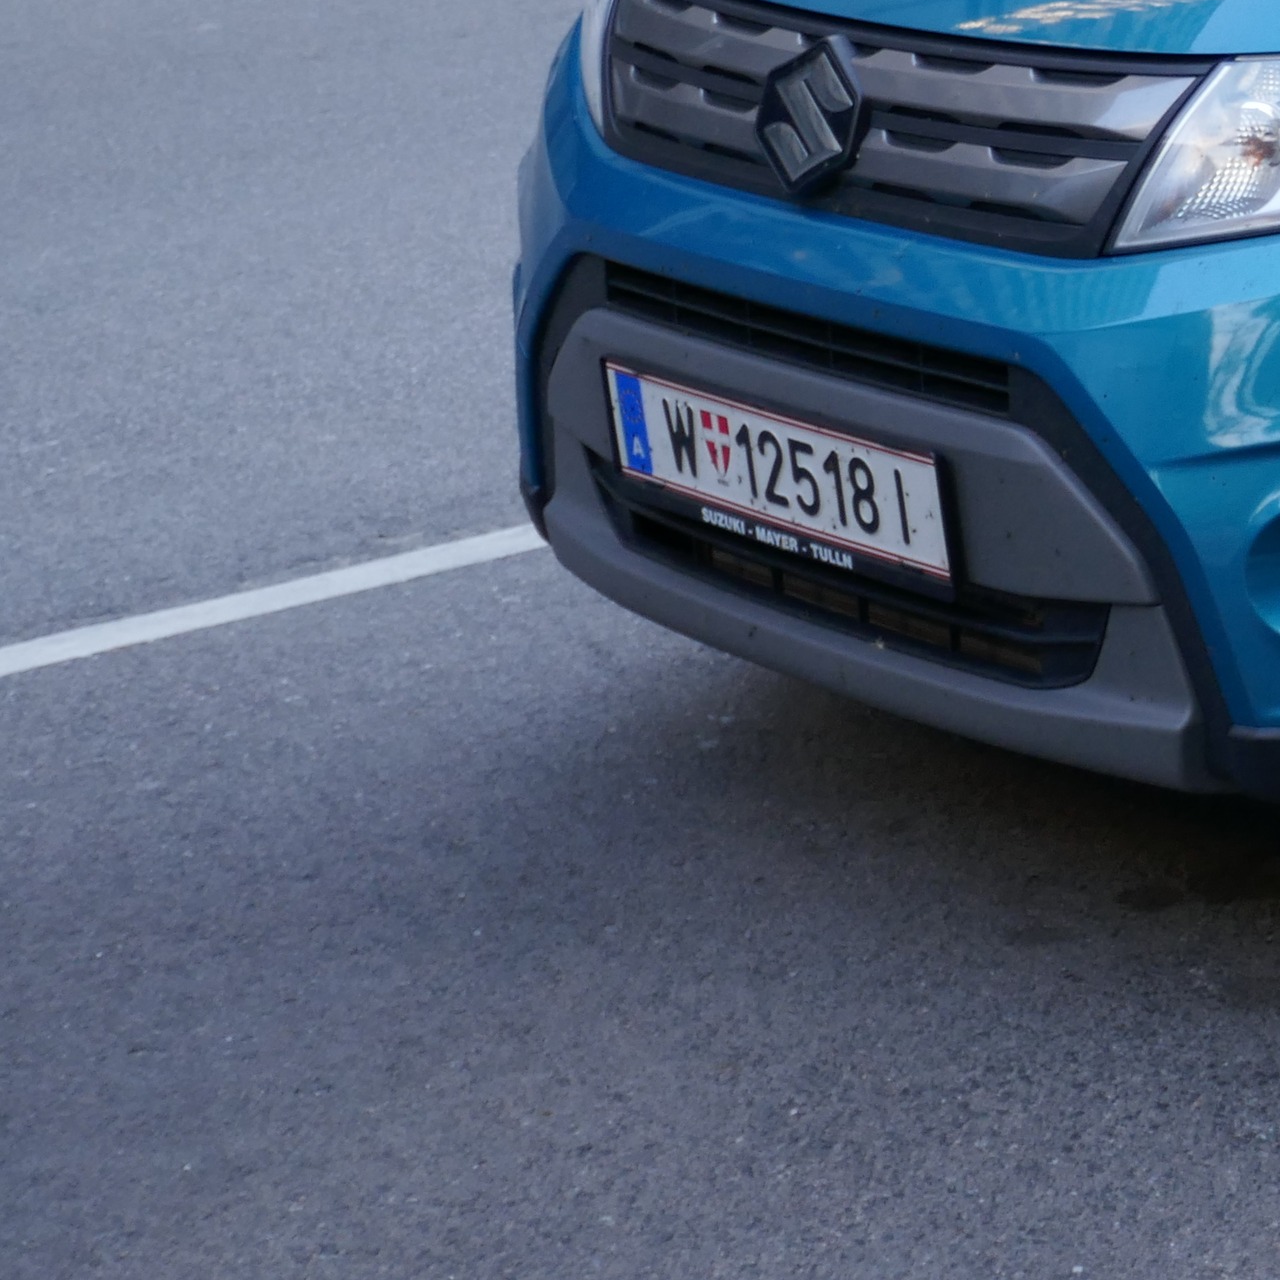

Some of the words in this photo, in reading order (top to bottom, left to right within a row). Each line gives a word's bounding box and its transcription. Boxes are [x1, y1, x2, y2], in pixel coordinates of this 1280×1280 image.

[632, 436, 647, 458] A
[662, 398, 698, 477] W
[735, 423, 880, 535] 12518
[894, 468, 911, 546] I
[701, 506, 747, 534] SUZUKI
[756, 525, 799, 554] MAYER
[809, 543, 854, 570] TULLN
